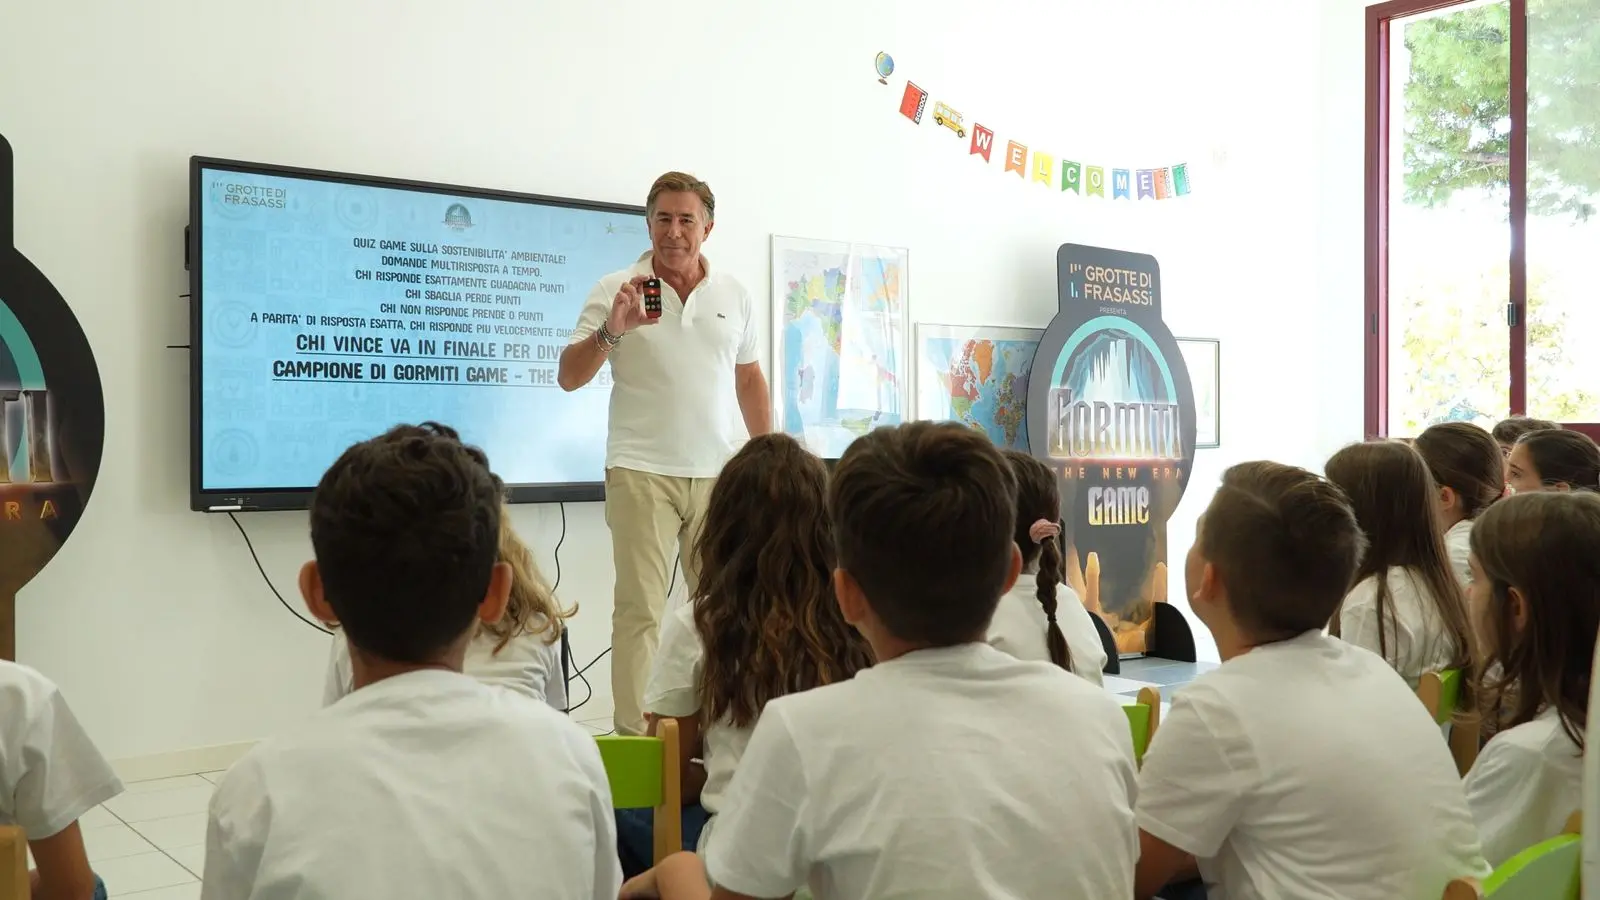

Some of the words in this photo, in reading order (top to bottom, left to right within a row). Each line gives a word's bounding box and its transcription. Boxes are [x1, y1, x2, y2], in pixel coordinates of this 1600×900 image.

[226, 184, 272, 197] GROTTE
[276, 188, 286, 198] DI
[353, 238, 376, 248] QUIZ
[380, 240, 407, 251] GAME
[410, 242, 438, 254] SULLA
[441, 245, 507, 260] SOSTENIBILITA'
[511, 251, 566, 264] AMBIENTALE!
[381, 256, 427, 268] DOMANDE
[431, 260, 499, 274] MULTIRISPOSTA
[502, 265, 508, 274] A
[512, 266, 543, 277] TEMPO.
[1085, 266, 1137, 286] GROTTE
[1140, 272, 1152, 288] DI
[355, 270, 372, 280] CHI
[376, 271, 421, 284] RISPONDE
[425, 274, 487, 288] ESATTAMENTE
[490, 280, 537, 292] GUADAGNA
[540, 283, 564, 294] PUNTI
[405, 288, 420, 298] CHI
[425, 290, 462, 302] SBAGLIA
[465, 293, 492, 304] PERDE
[496, 295, 521, 306] PUNTI
[380, 303, 396, 314] CHI
[400, 304, 421, 314] NON
[425, 306, 468, 318] RISPONDE
[472, 308, 506, 320] PRENDE
[518, 312, 544, 322] PUNTI
[1100, 307, 1127, 315] PRESENTA
[250, 312, 258, 322] A
[262, 313, 301, 324] PARITA'
[306, 316, 316, 326] DI
[320, 316, 366, 328] RISPOSTA
[370, 318, 406, 330] ESATTA,
[410, 320, 425, 330] CHI
[430, 322, 472, 334] RISPONDE
[476, 324, 490, 334] PIU
[494, 325, 552, 336] VELOCEMENTE
[296, 334, 325, 351] CHI
[334, 336, 383, 354] VINCE
[390, 338, 410, 354] VA
[418, 340, 436, 356] IN
[444, 340, 496, 358] FINALE
[504, 343, 530, 359] PER
[273, 360, 363, 380] CAMPIONE
[370, 364, 386, 380] DI
[394, 364, 458, 382] GORMITI
[466, 366, 508, 383] GAME
[528, 368, 554, 384] THE
[1048, 387, 1182, 458] GORMITI
[1103, 467, 1137, 479] NEW
[1152, 467, 1182, 479] ERA
